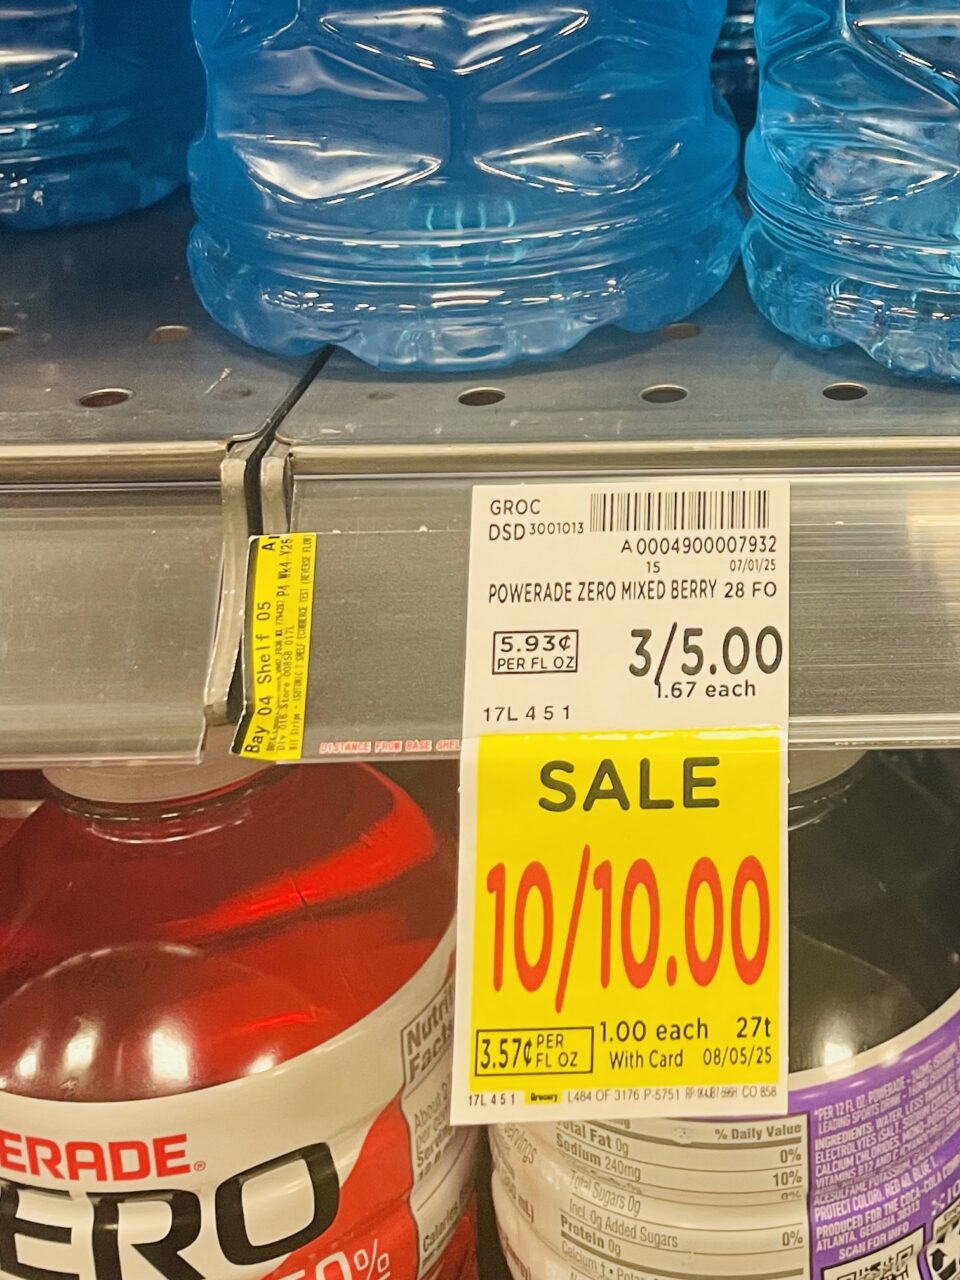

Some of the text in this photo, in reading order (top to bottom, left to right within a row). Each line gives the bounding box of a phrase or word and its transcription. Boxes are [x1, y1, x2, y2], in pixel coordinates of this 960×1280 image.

[490, 498, 541, 516] GROC
[488, 521, 585, 541] DSD 3001013
[646, 562, 661, 574] 15
[729, 558, 777, 572] 07/01/25
[488, 579, 778, 604] POWERADE ZERO MIXED BERRY 28 FO
[500, 634, 572, 653] 5.93¢
[628, 621, 784, 687] 3/5.00
[497, 656, 576, 671] PER FL OZ
[244, 600, 273, 754] Bay 04 Shelf 05
[656, 680, 756, 699] 1.67 each
[483, 705, 554, 722] 17L 4 5
[538, 756, 720, 812] SALE
[486, 844, 770, 1013] 10/10.00
[536, 1033, 564, 1049] PER
[599, 1016, 771, 1043] 1.00 each 27t
[480, 1037, 533, 1070] 3.57¢
[535, 1051, 578, 1068] FL OZ
[609, 1045, 772, 1069] With Card 08/05/25
[468, 1090, 640, 1107] 17L L484 OF 3176
[731, 1124, 802, 1141] Daily Value
[589, 1129, 802, 1164] Fat 0g 0%
[555, 1133, 803, 1186] Sodium 240mg 10%
[591, 1180, 626, 1212] Sugars
[560, 1214, 606, 1250] Protein
[605, 1217, 804, 1249] Added Sugars 0%
